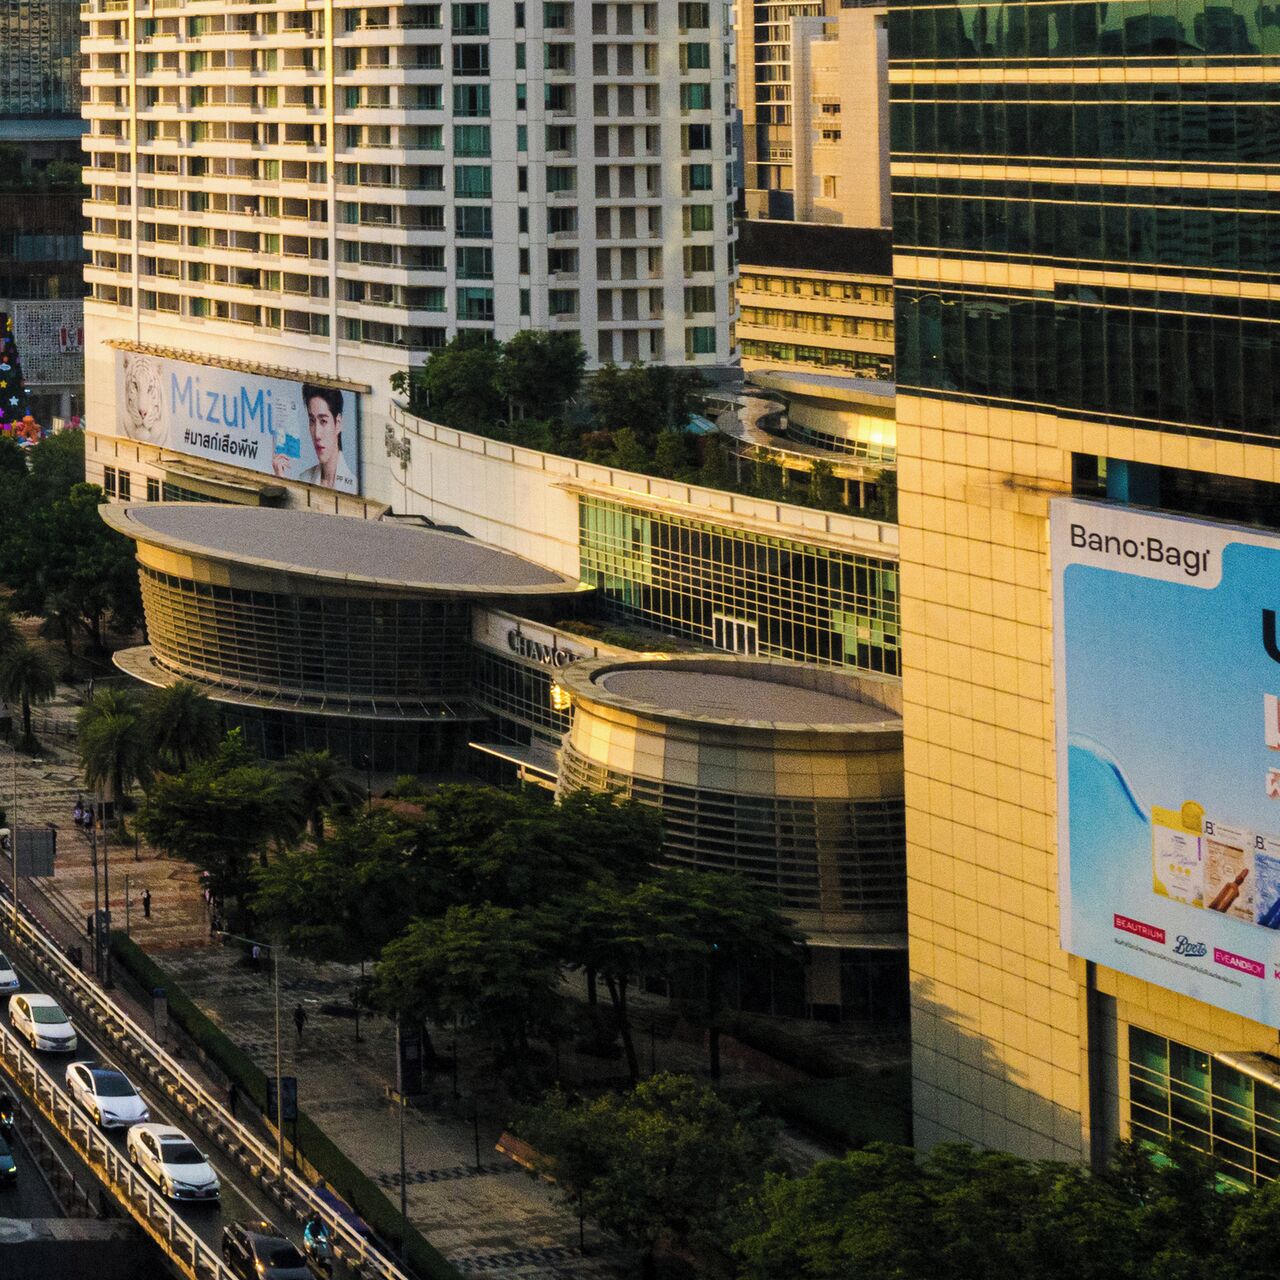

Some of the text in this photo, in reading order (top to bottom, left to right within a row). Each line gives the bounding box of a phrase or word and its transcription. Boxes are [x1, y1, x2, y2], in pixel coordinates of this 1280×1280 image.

[171, 372, 279, 436] MizuMi
[1116, 917, 1163, 940] BEAUTRIUM
[1172, 935, 1208, 957] Boots
